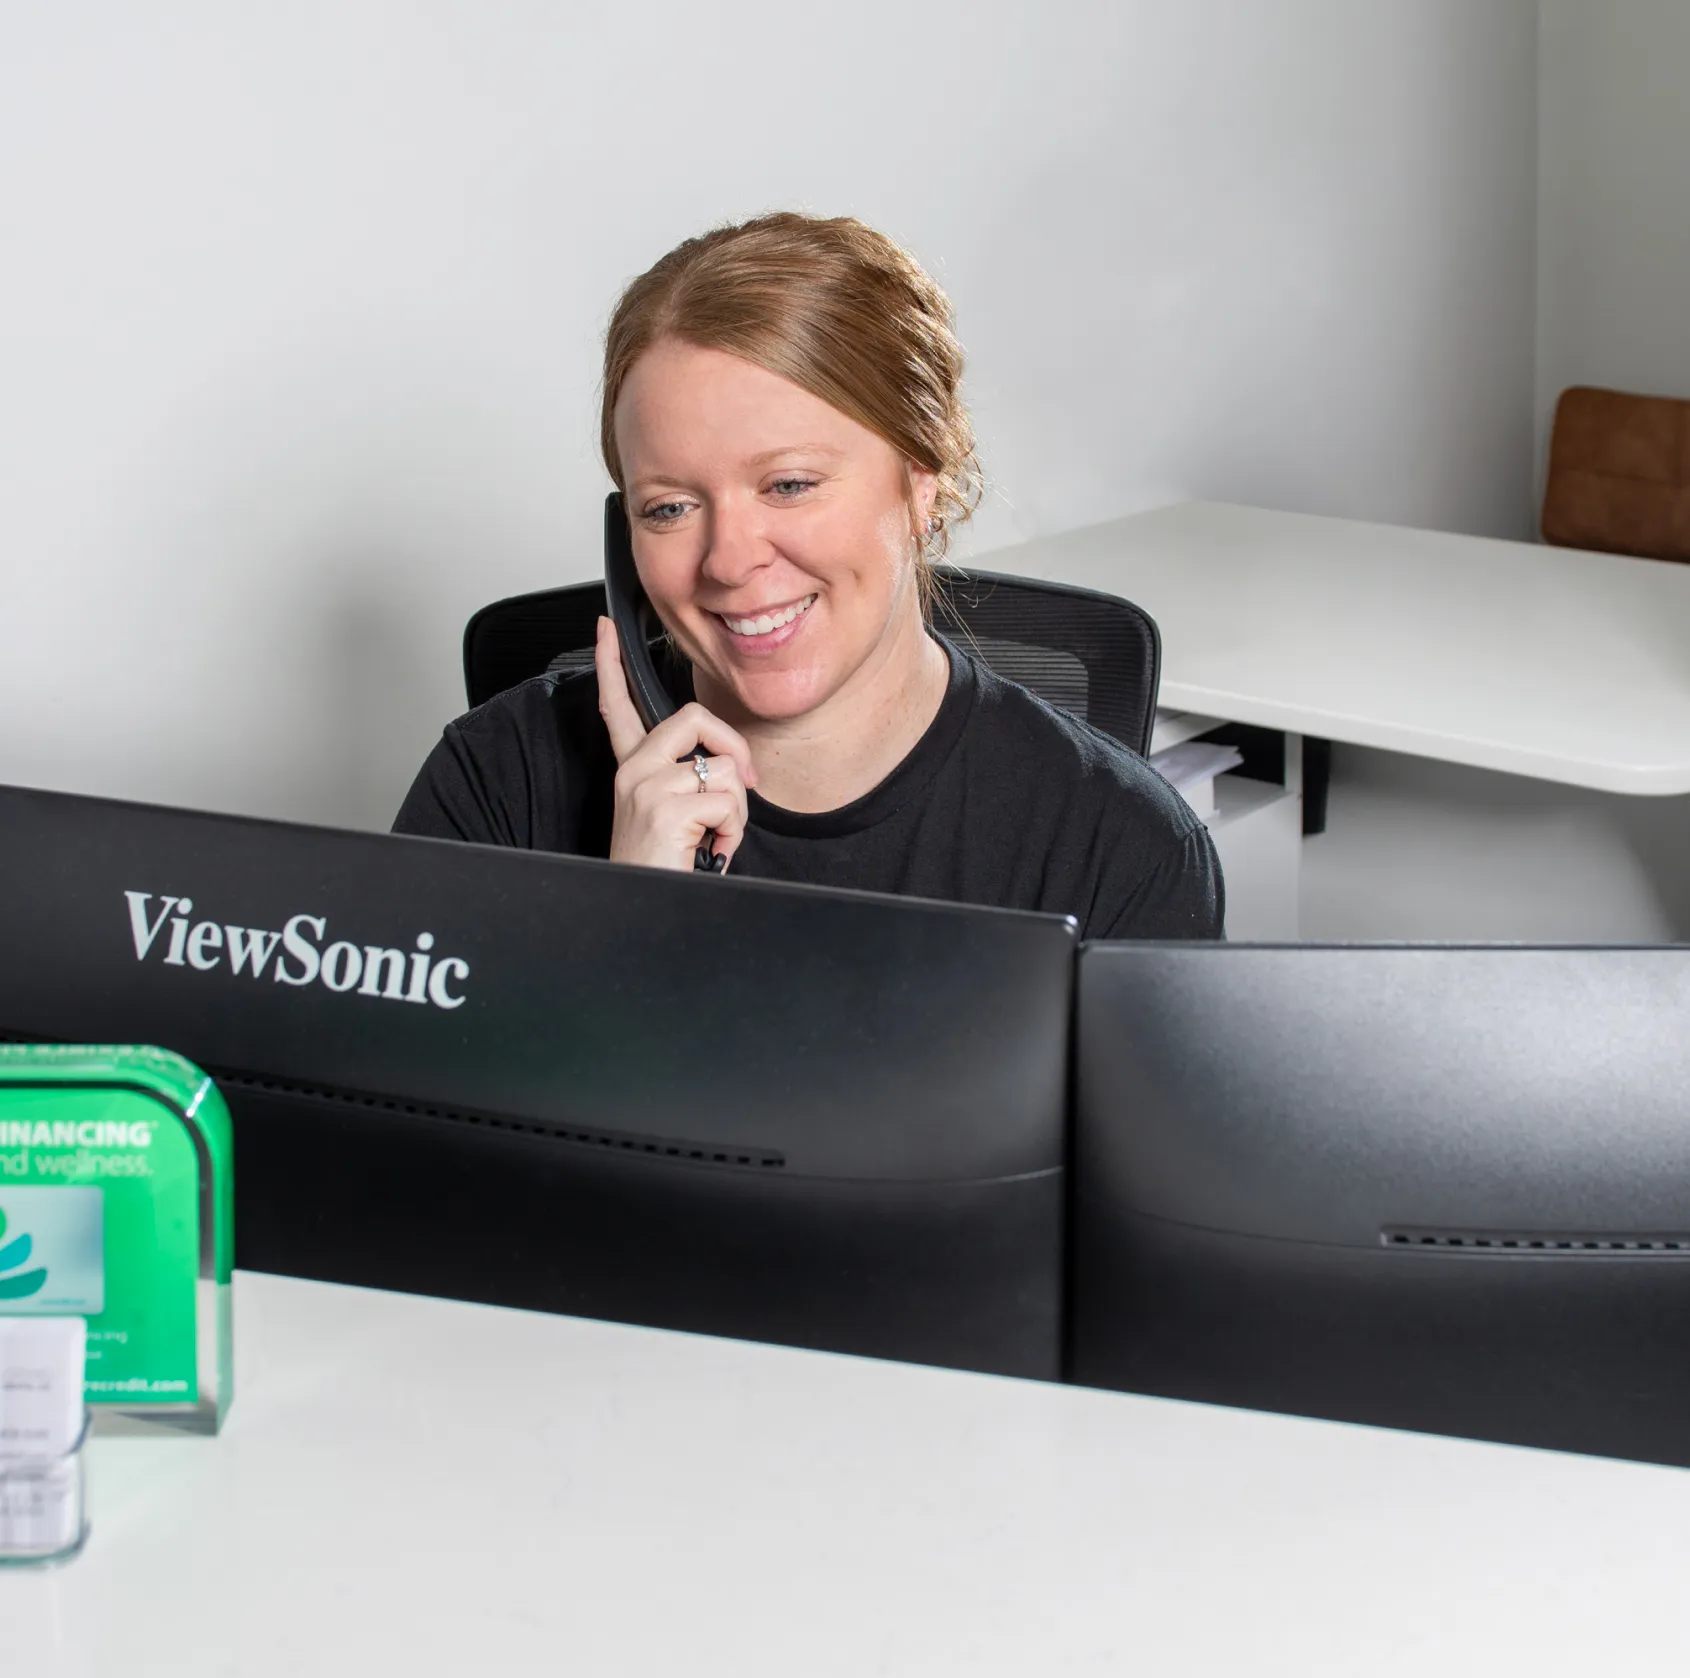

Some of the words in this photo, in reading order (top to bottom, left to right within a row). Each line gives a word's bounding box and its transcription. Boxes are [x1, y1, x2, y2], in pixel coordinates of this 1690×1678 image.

[124, 890, 469, 1009] ViewSonic
[0, 1120, 151, 1147] INANCING
[0, 1147, 29, 1176] nd
[84, 1377, 188, 1392] recredit.com
